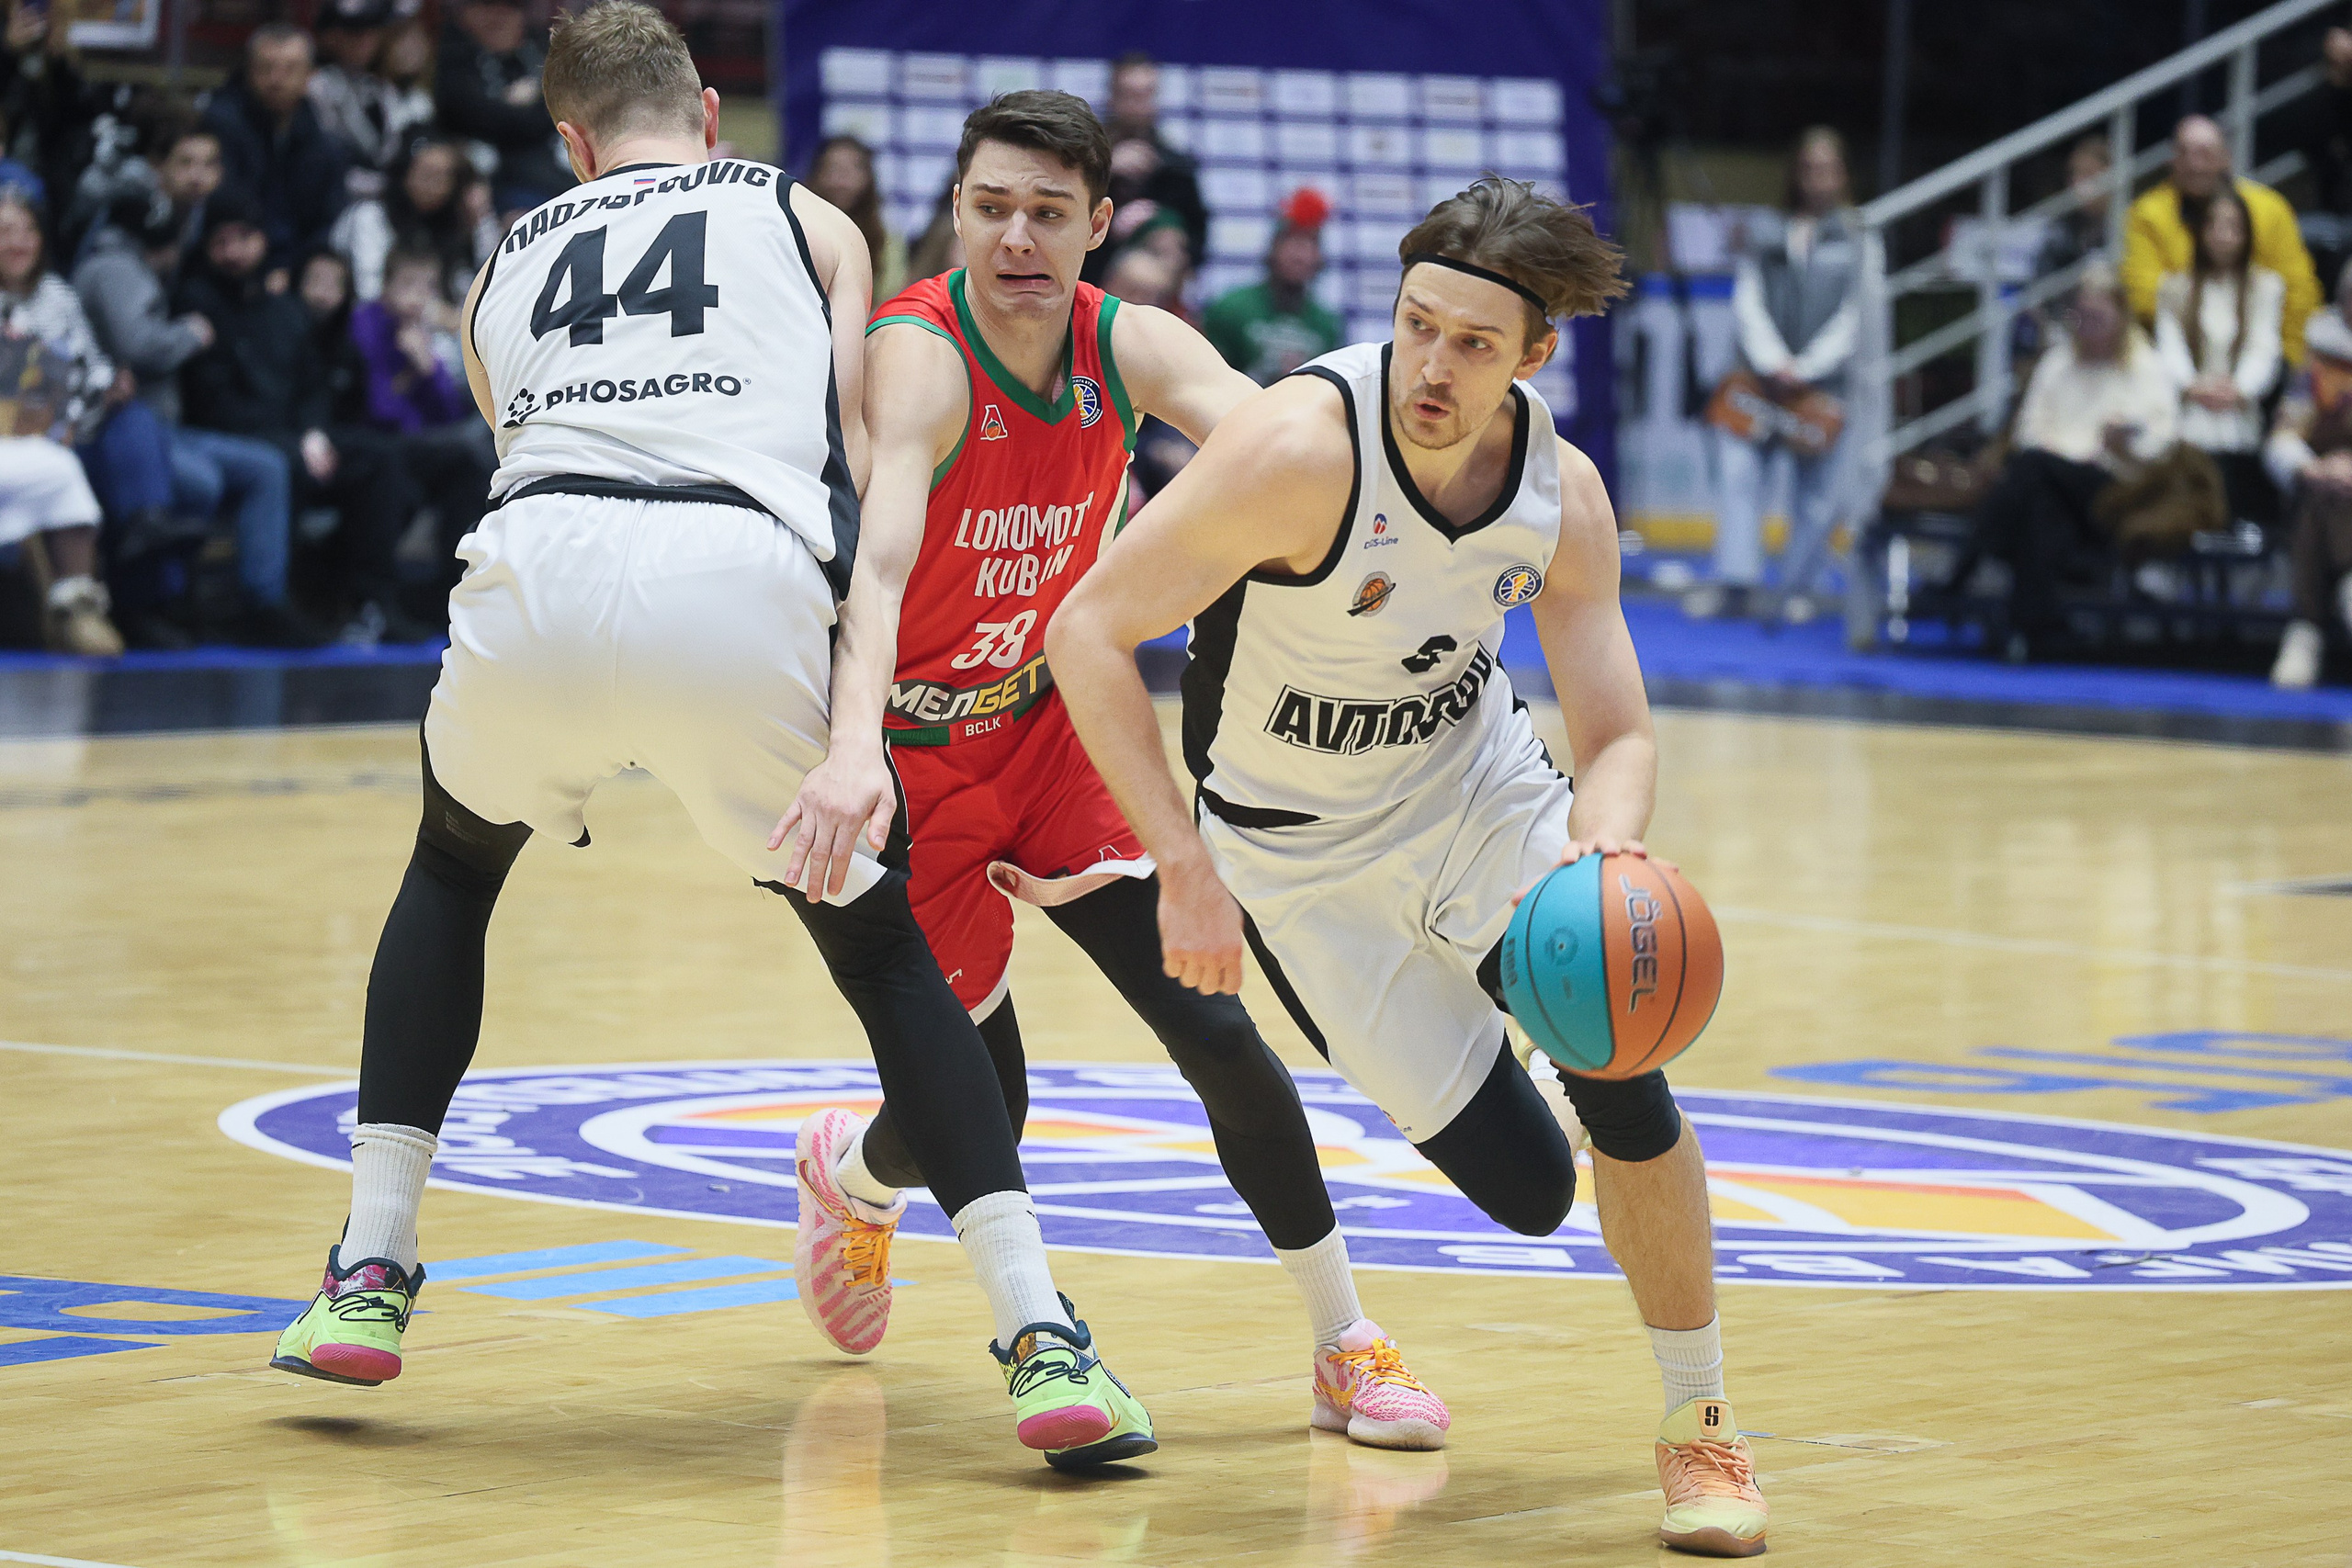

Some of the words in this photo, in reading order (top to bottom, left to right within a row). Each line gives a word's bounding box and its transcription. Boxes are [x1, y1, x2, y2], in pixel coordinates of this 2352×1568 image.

[530, 210, 718, 348] 44
[546, 372, 742, 411] PHOSAGRO
[950, 609, 1038, 670] 38
[965, 716, 1001, 737] BCLK
